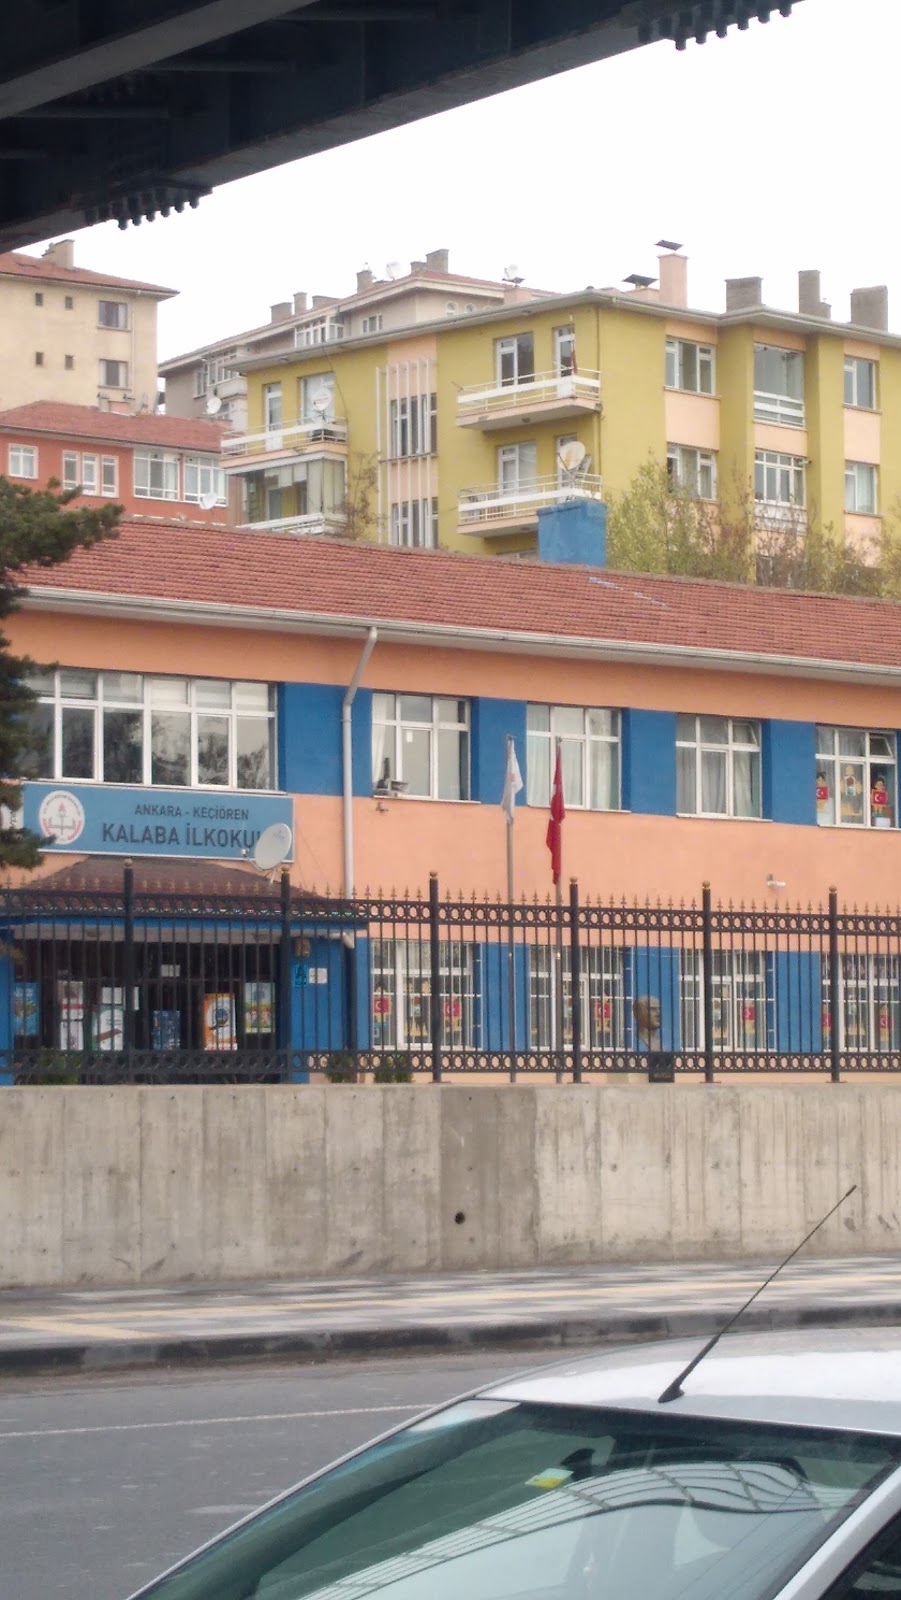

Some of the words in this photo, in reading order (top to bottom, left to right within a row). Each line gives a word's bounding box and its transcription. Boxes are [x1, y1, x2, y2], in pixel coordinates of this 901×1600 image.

[134, 803, 182, 817] ANKARA
[193, 805, 249, 820] KEÇİÖREN
[102, 822, 180, 845] KALABA
[186, 822, 261, 849] İLKOKU
